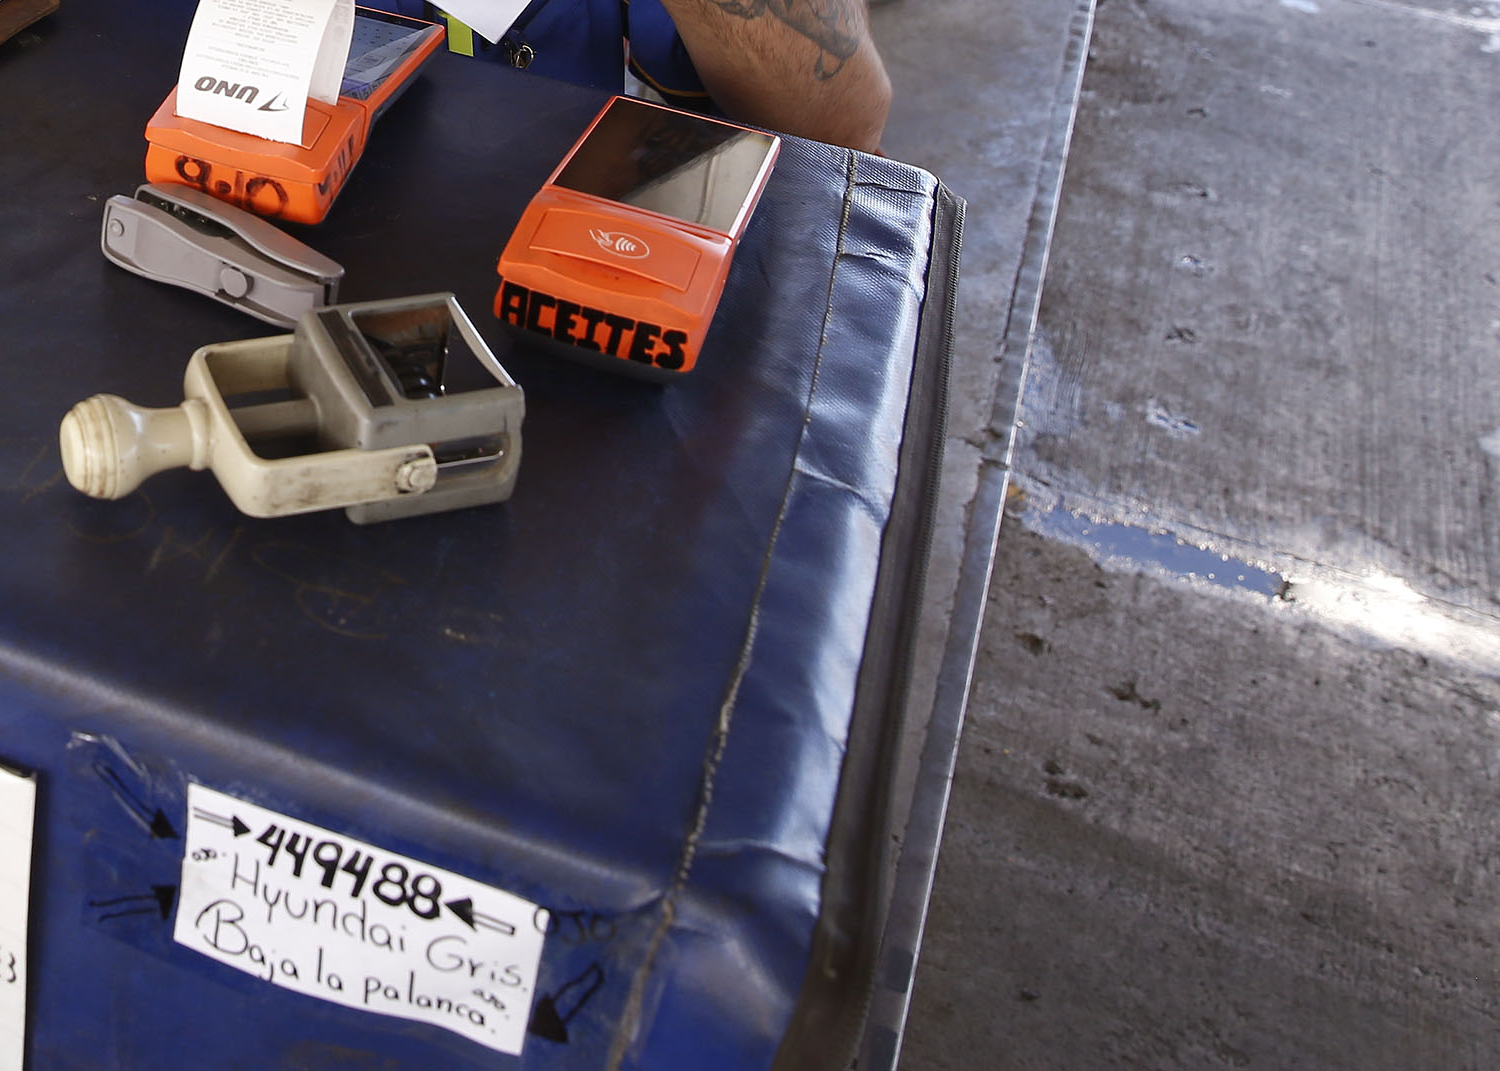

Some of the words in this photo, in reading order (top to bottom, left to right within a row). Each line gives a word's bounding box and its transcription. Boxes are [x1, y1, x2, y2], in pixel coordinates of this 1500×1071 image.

[194, 75, 260, 105] UNO
[501, 280, 688, 371] ACEITES
[231, 852, 408, 954] Hyundai
[257, 824, 443, 920] 449488
[195, 898, 299, 982] Baja
[317, 947, 344, 993] la
